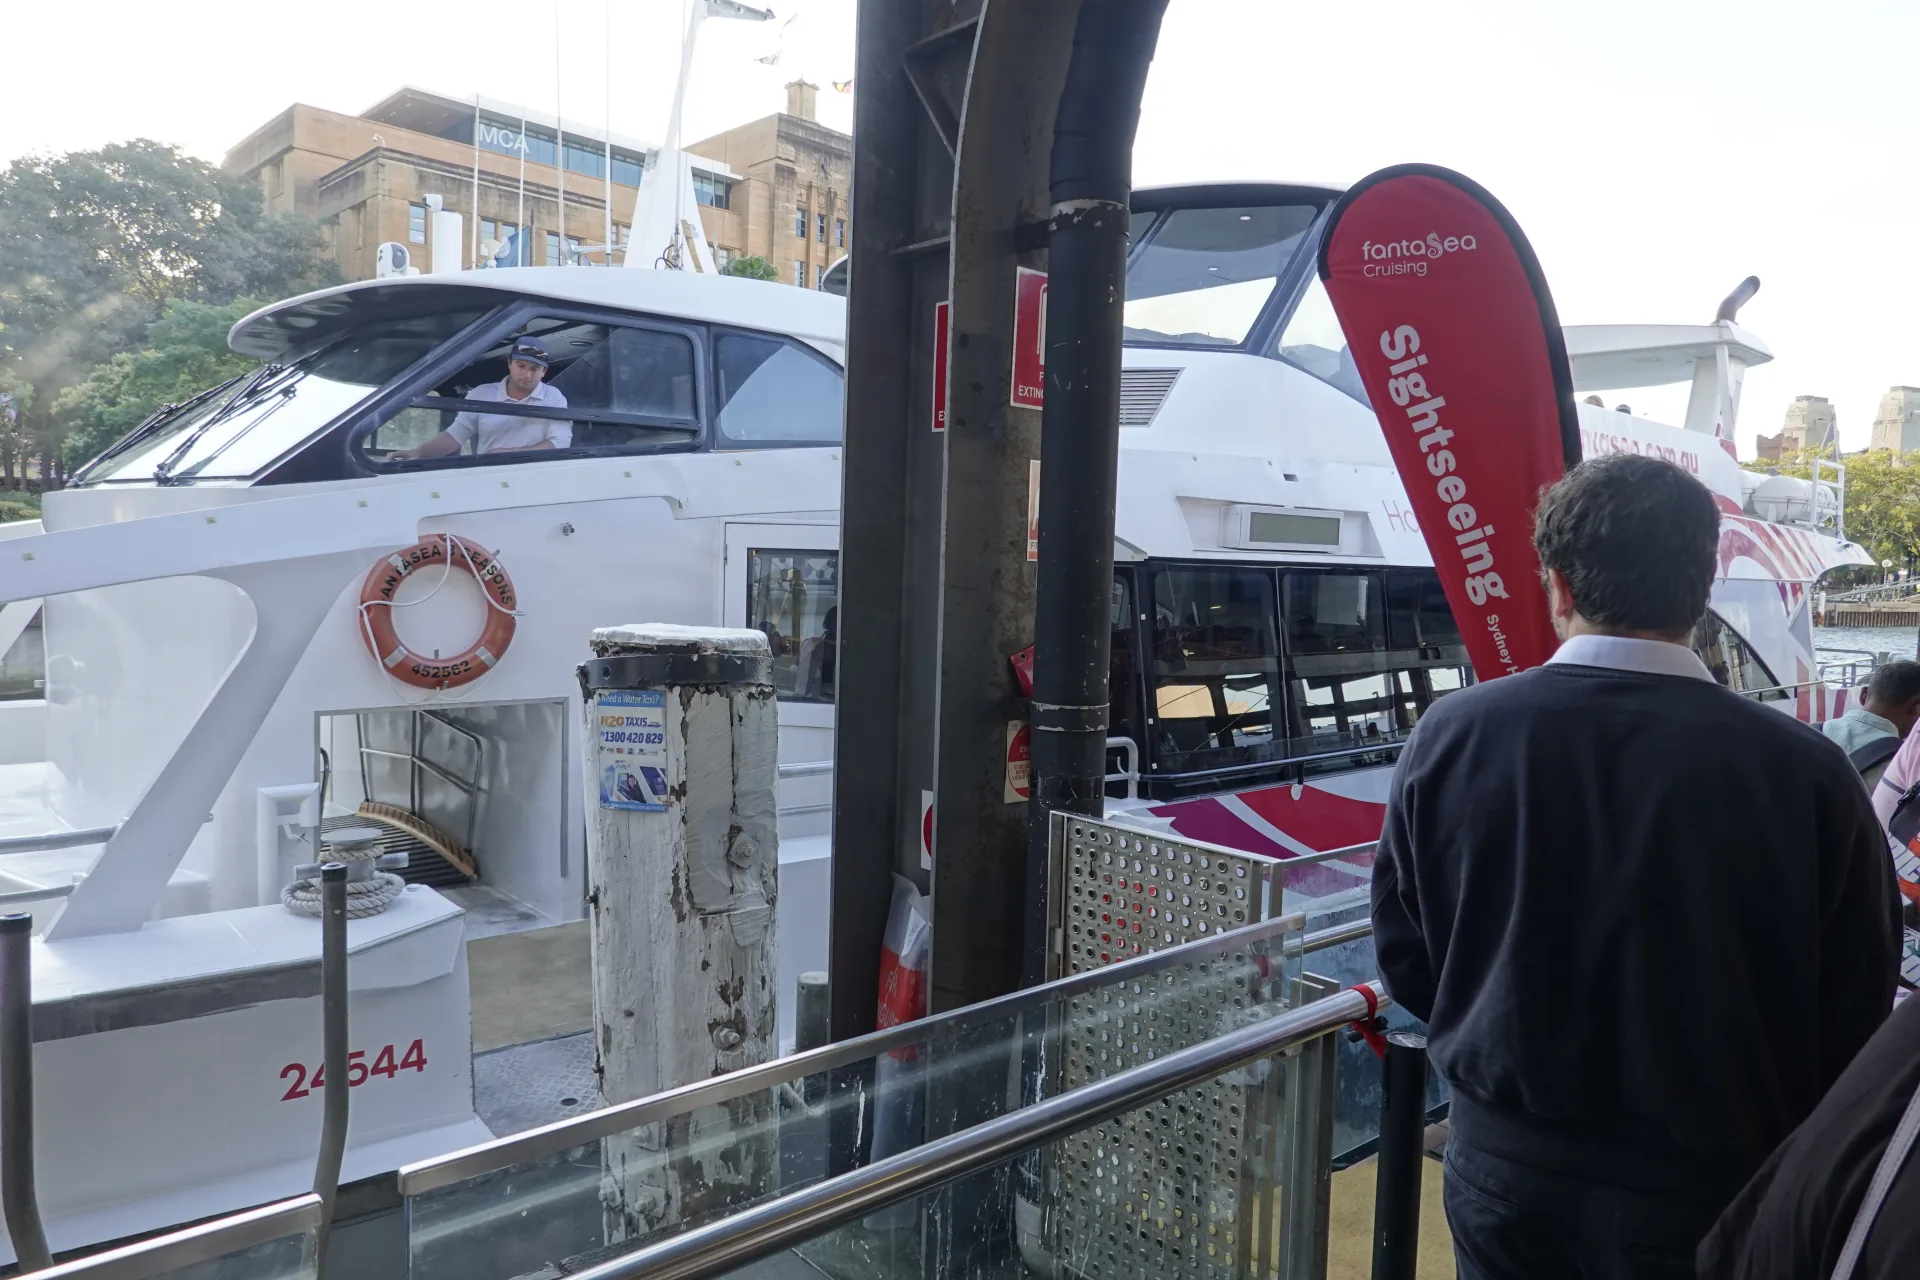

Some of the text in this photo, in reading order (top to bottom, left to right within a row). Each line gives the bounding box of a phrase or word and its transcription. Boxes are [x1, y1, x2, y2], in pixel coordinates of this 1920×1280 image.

[479, 124, 530, 153] MCA
[1363, 261, 1427, 277] Cruising
[1380, 324, 1510, 606] Sightseeing
[376, 544, 442, 607] ANTASEA
[1486, 614, 1513, 664] Sydney
[411, 660, 472, 679] 452562
[625, 716, 648, 727] TAXIS
[605, 731, 626, 743] 1300
[626, 732, 645, 744] 420
[645, 733, 664, 745] 829
